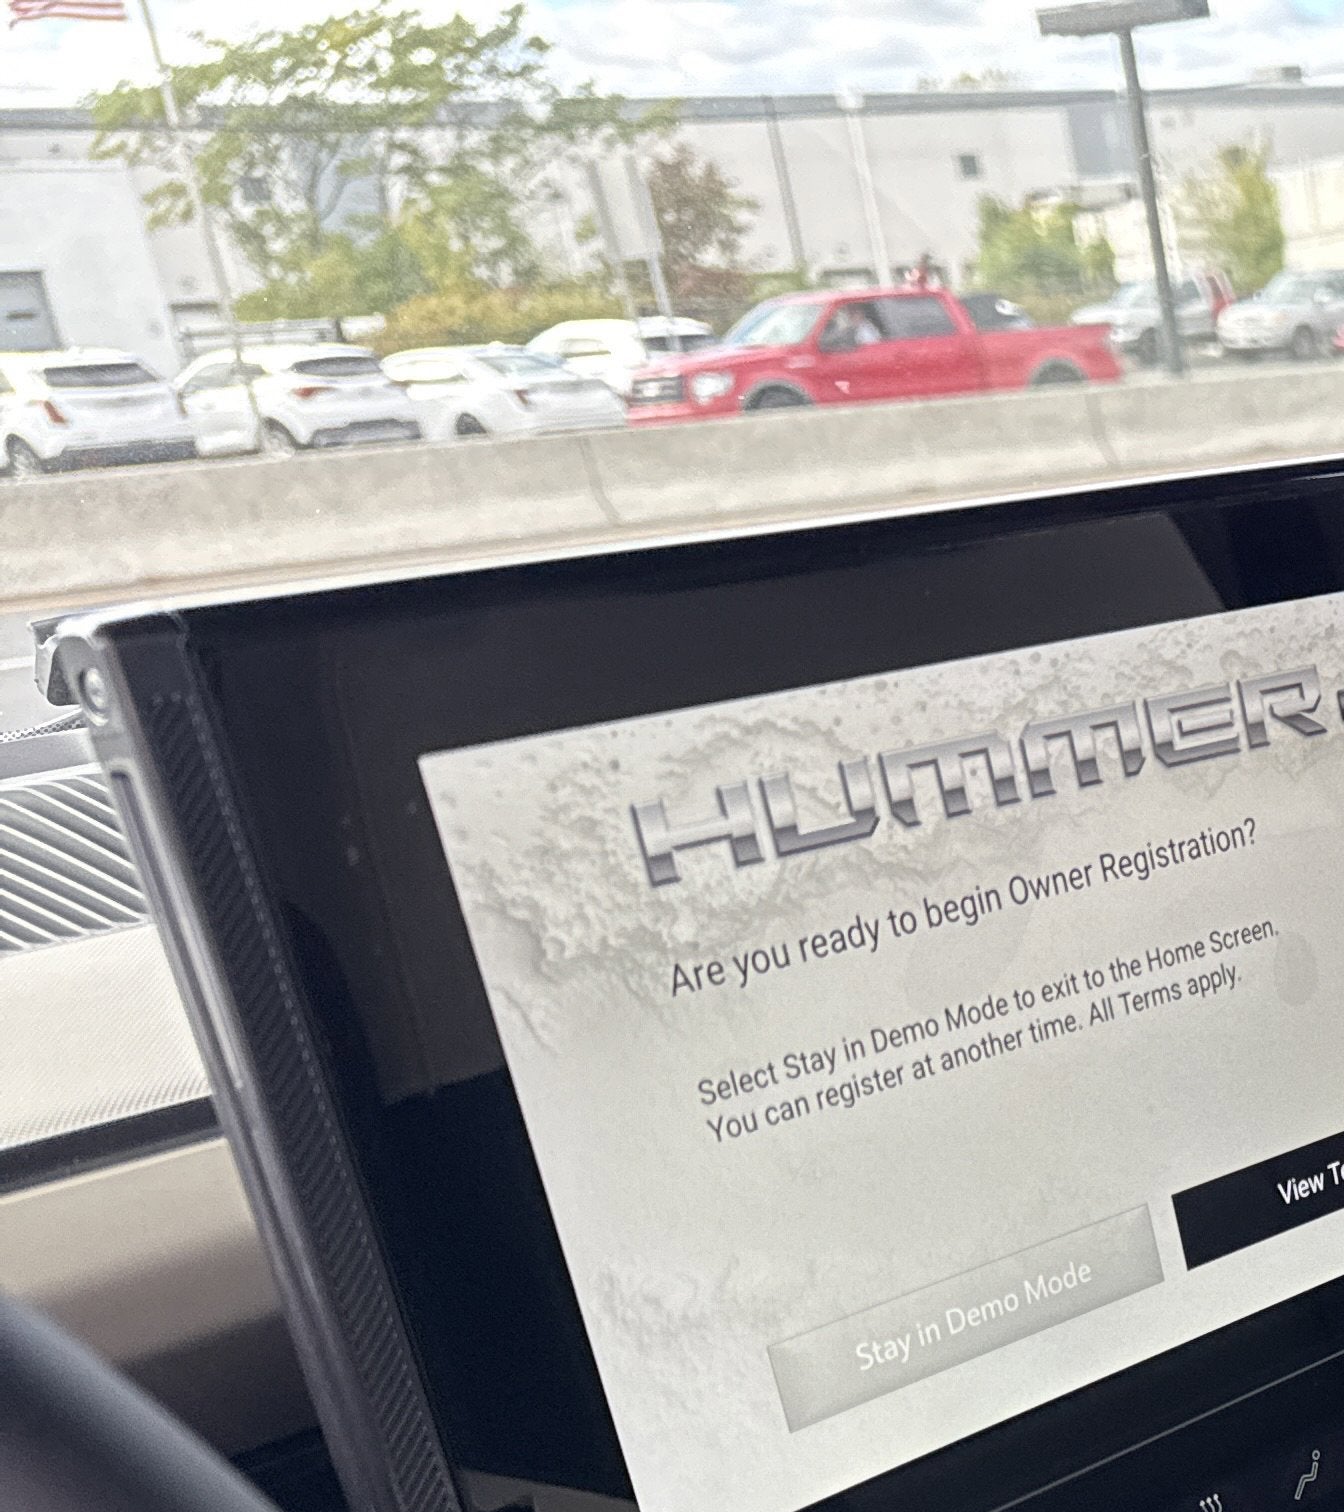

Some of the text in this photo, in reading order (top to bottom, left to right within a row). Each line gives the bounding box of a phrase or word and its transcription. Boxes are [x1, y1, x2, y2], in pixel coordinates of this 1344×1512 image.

[630, 664, 1329, 887] HUMMER
[672, 818, 1255, 997] Are you ready to begin Owner Registration?
[698, 921, 1279, 1105] Select Stay in Demo Mode to exit to the Home Screen.
[706, 963, 1241, 1142] You can register at another time. All Terms apply.
[1278, 1173, 1323, 1204] View
[856, 1262, 1091, 1370] Stay in Demo Mode
